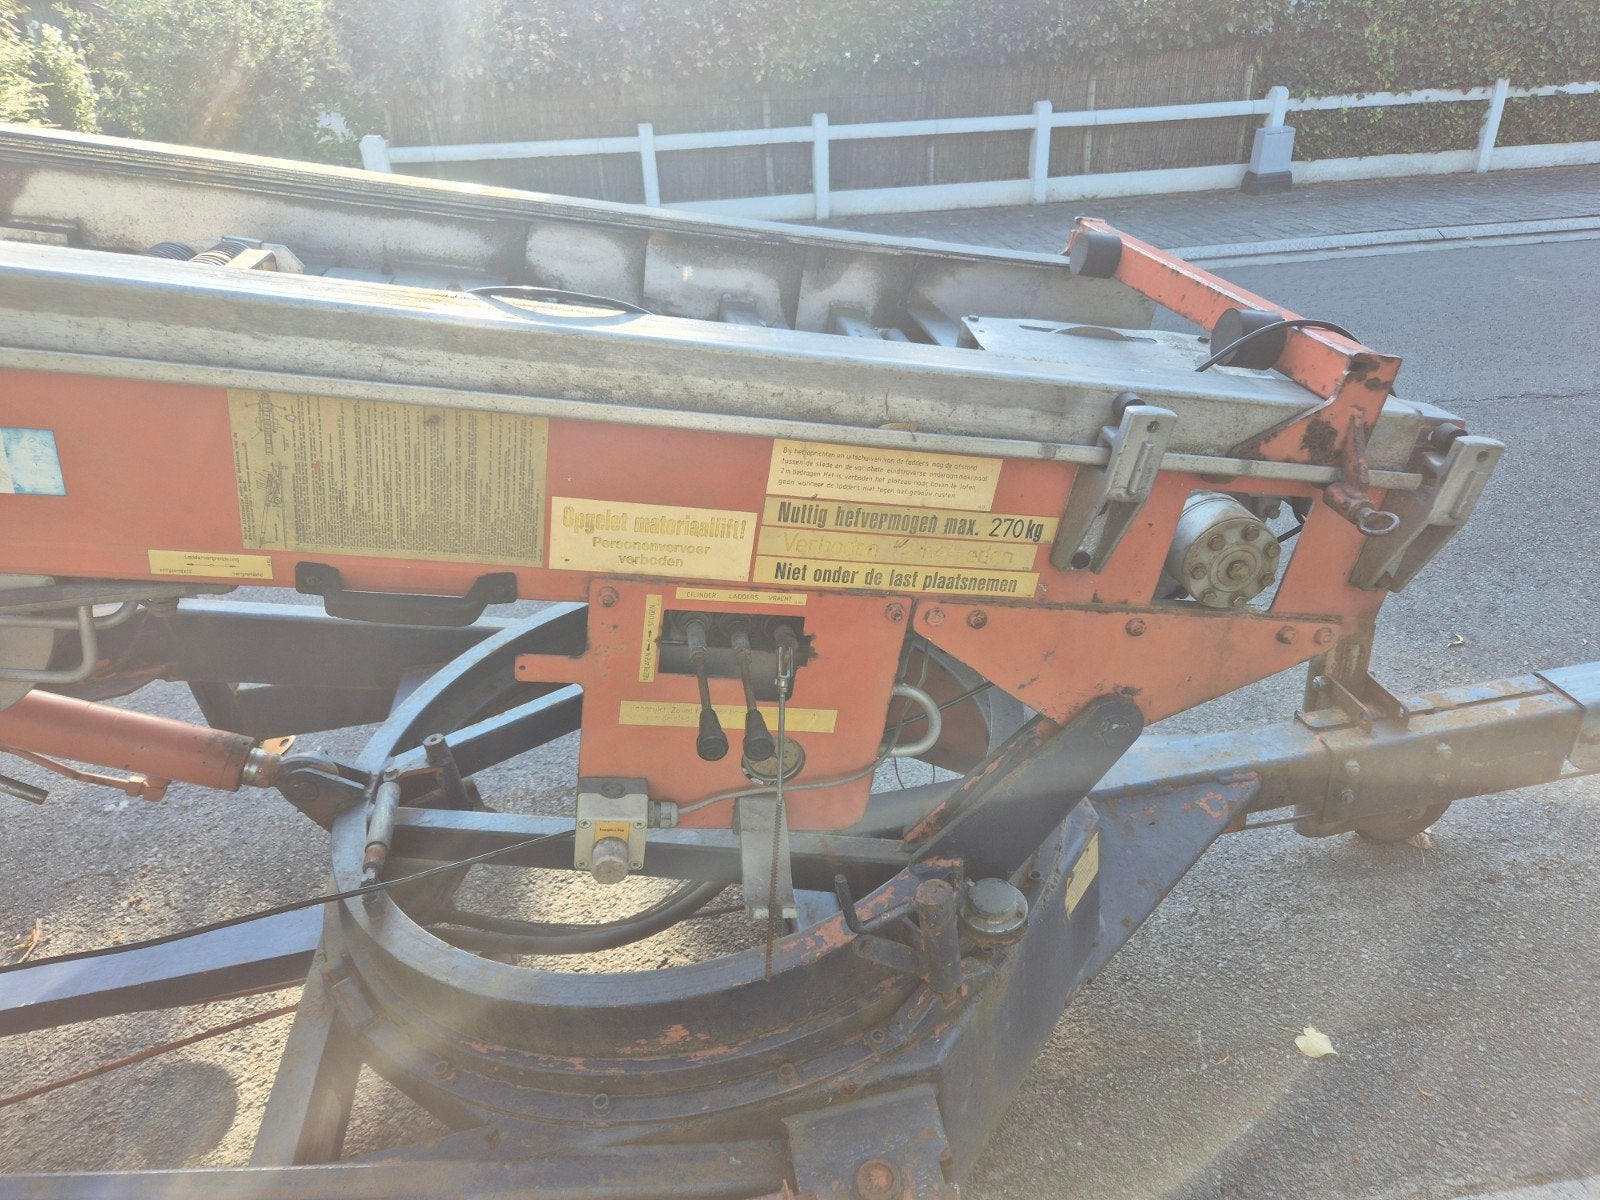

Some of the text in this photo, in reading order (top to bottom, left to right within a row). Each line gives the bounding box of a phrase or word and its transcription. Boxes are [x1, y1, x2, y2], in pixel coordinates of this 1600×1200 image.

[783, 447, 792, 455] Bij
[805, 450, 835, 458] oprichten
[846, 454, 882, 463] uitschuiven
[905, 459, 928, 467] ladders
[836, 483, 860, 491] ladders
[909, 489, 933, 497] gebouw
[562, 505, 747, 540] Opgelet materiaallift!
[778, 501, 828, 529] Nuttig
[835, 508, 937, 537] hefvermogen
[943, 515, 979, 536] max.
[592, 536, 711, 555] Personenvervoer
[618, 553, 684, 567] verboden
[774, 561, 1018, 593] Niet onder de last plaatsnemen
[686, 591, 717, 599] CILINDER
[728, 593, 759, 601] LADDERS
